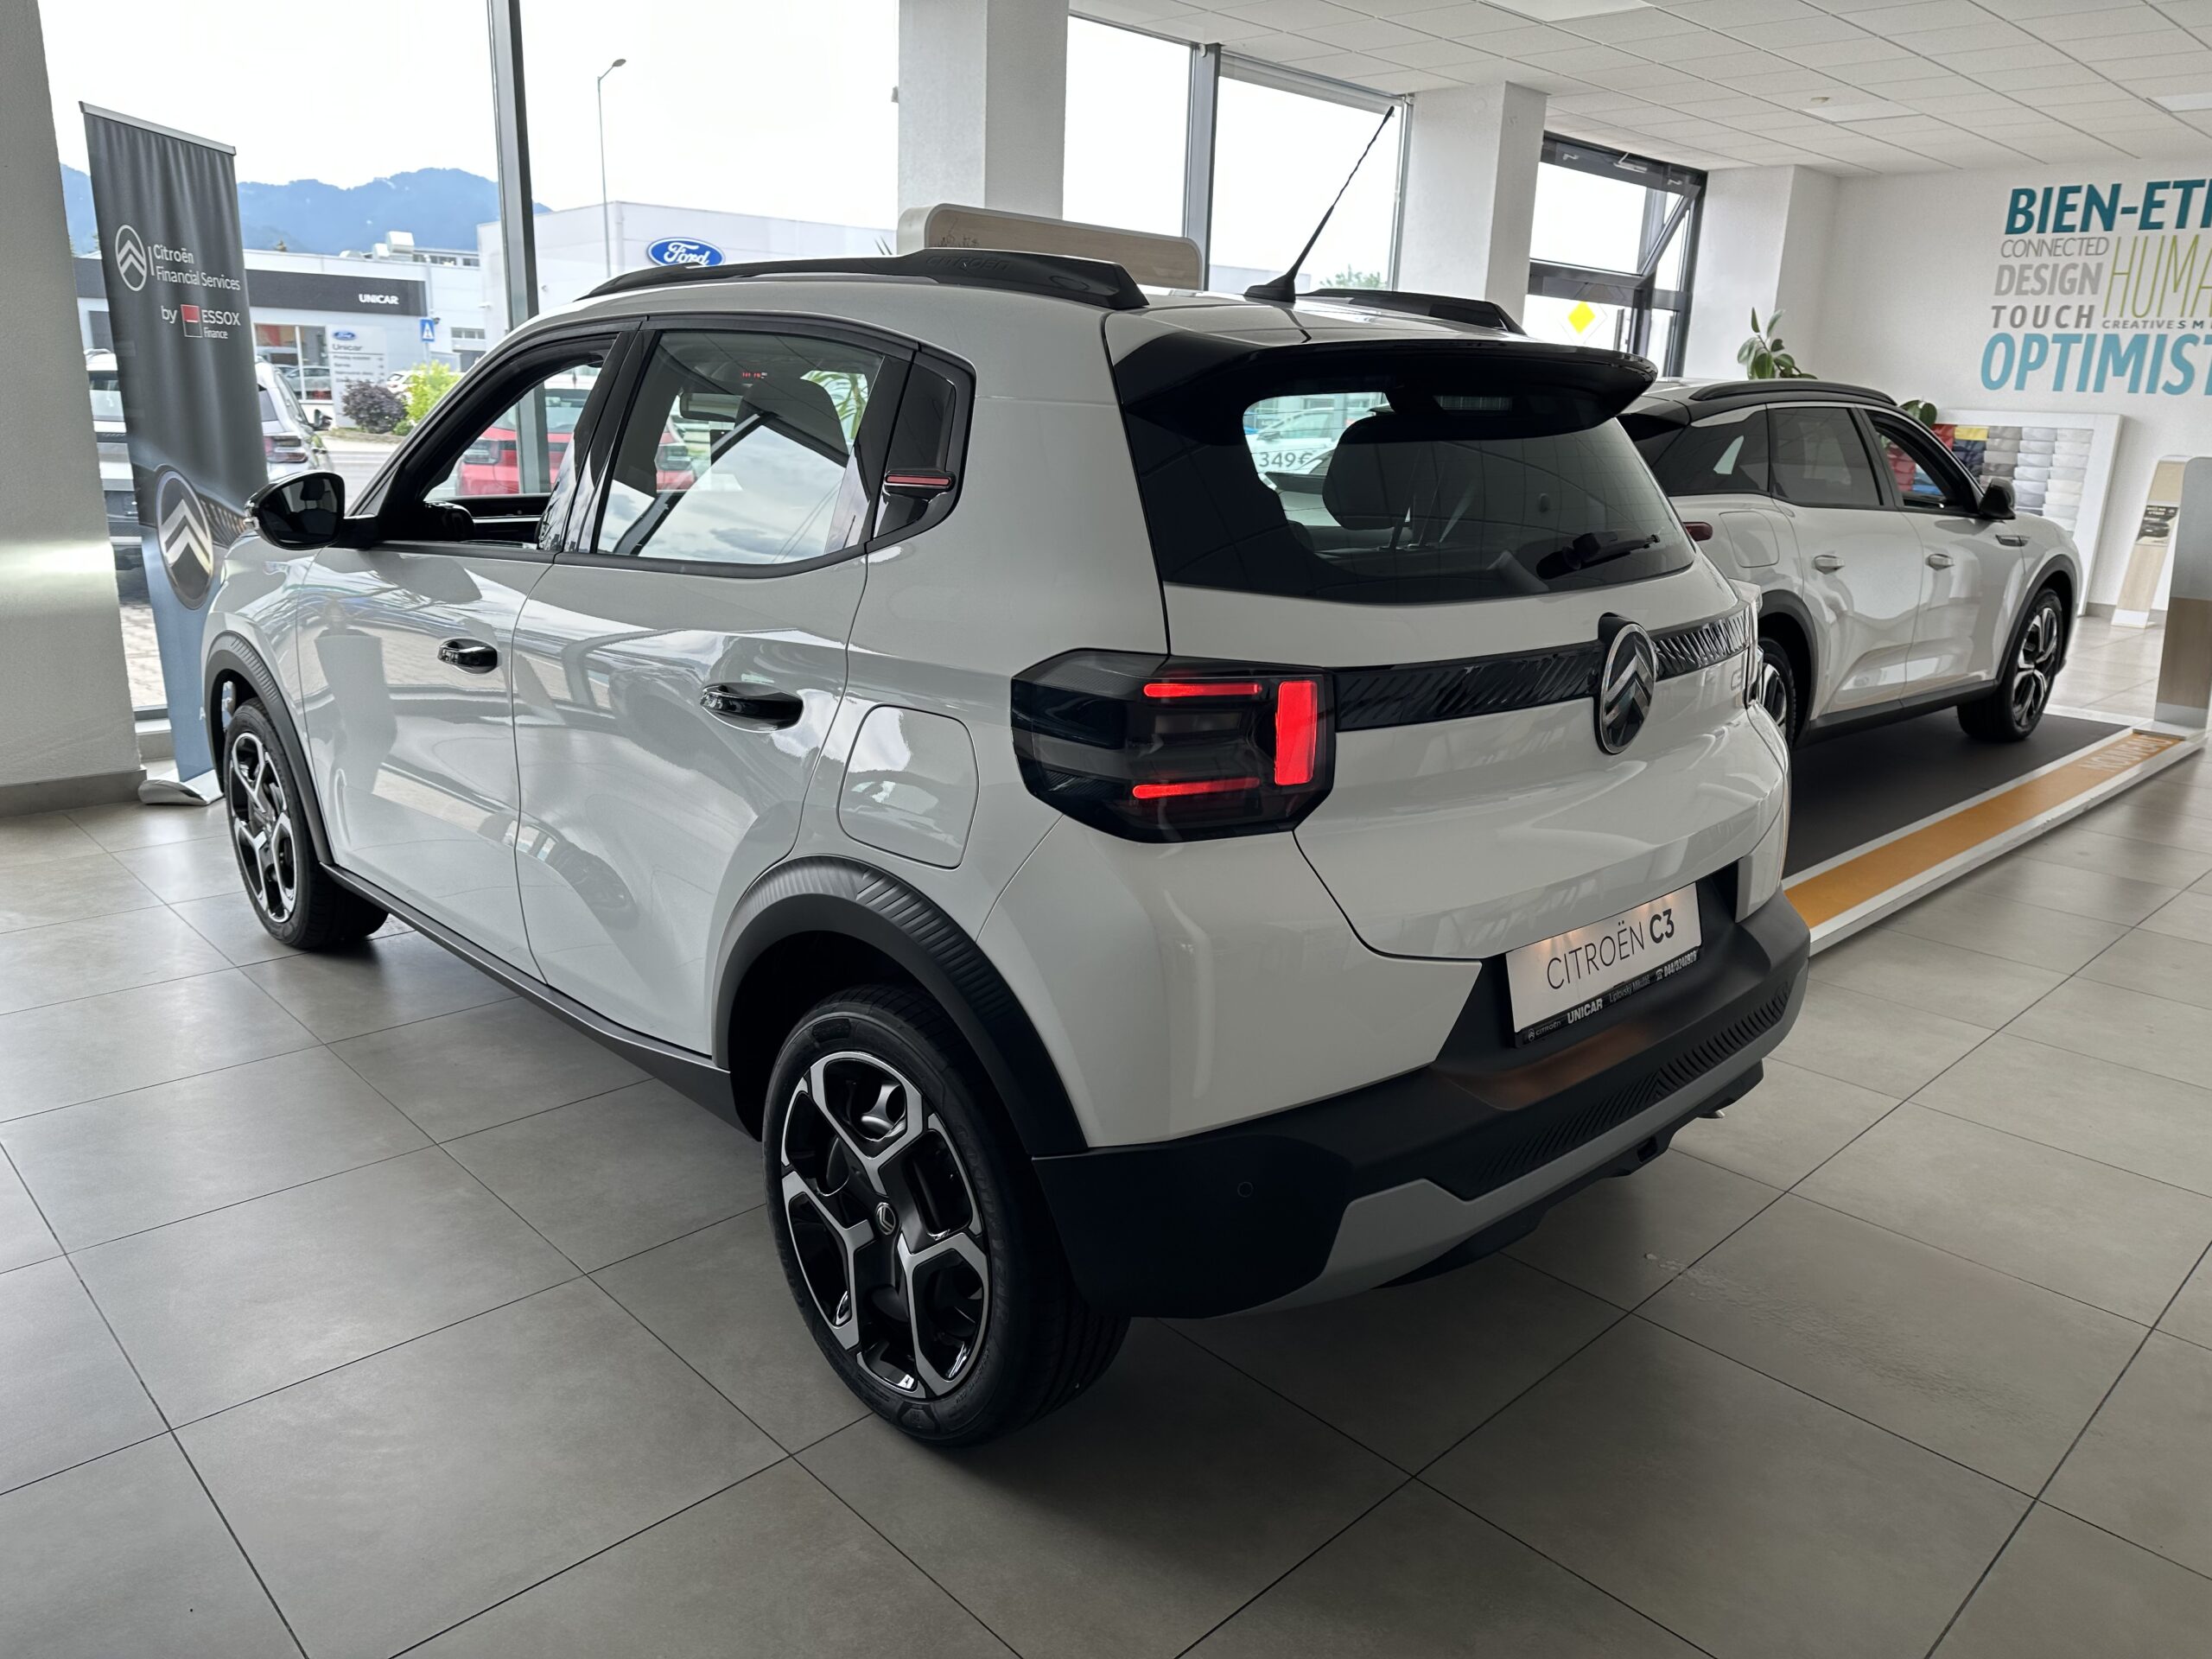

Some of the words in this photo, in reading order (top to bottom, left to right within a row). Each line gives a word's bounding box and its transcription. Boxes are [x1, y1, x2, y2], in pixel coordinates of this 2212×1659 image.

[153, 244, 194, 264] Citroën
[663, 242, 711, 265] Ford
[2000, 237, 2110, 257] CONNECTED
[156, 265, 200, 286] Financial
[200, 272, 241, 291] Services
[1993, 262, 2104, 296] DESIGN
[359, 293, 399, 305] UNICAR
[161, 305, 177, 324] by
[201, 309, 241, 326] ESSOX
[1991, 304, 2095, 329] TOUCH
[2101, 320, 2174, 329] CREATIVE
[2177, 320, 2212, 329] SM
[203, 327, 229, 339] Finance
[1547, 920, 1645, 989] CITROËN
[1649, 908, 1675, 944] C3
[1567, 998, 1604, 1024] UNICAR
